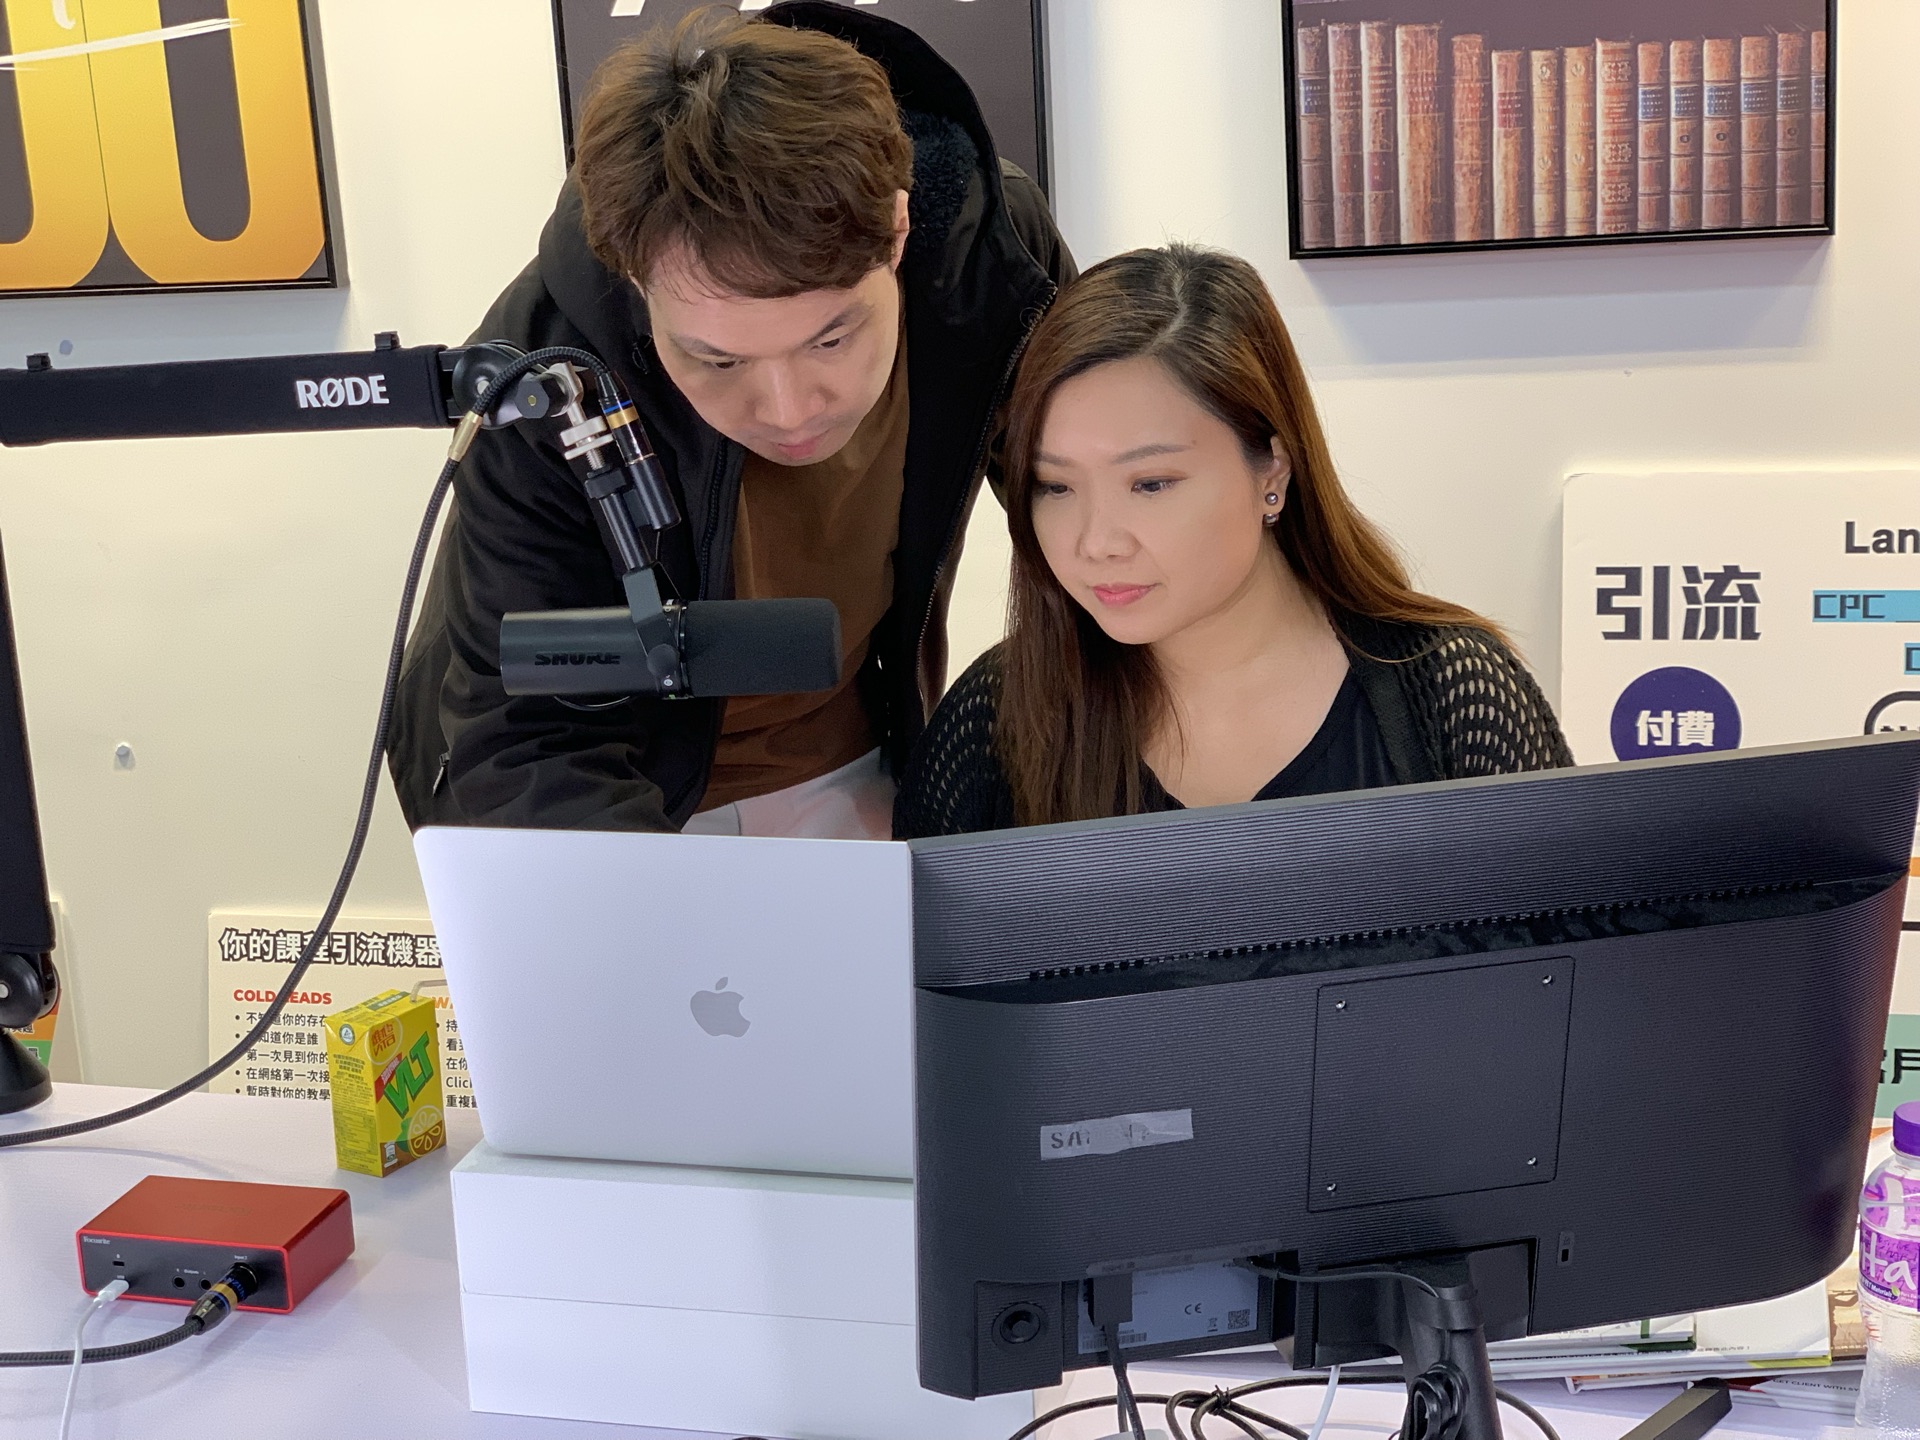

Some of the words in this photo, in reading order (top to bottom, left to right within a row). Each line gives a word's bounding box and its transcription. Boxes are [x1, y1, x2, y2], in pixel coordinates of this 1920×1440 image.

[296, 374, 389, 408] RØDE
[1596, 565, 1761, 640] 引流
[1814, 594, 1886, 618] CPC
[534, 652, 621, 666] SHURE
[1635, 710, 1715, 747] 付費
[233, 989, 276, 1002] COLD
[285, 991, 333, 1004] EADS
[246, 1031, 319, 1046] 知道你是誰
[446, 1077, 472, 1088] Clic
